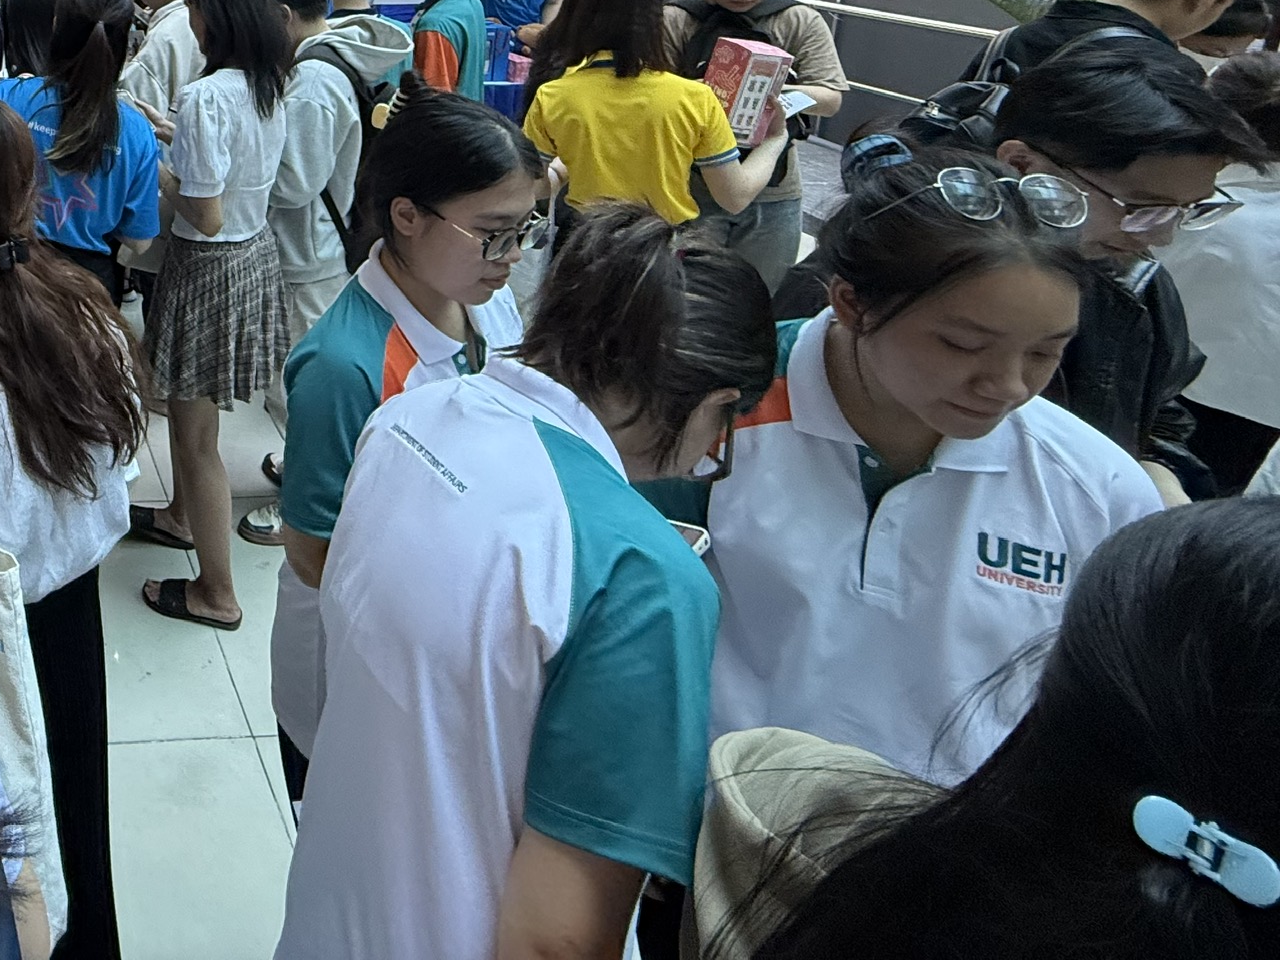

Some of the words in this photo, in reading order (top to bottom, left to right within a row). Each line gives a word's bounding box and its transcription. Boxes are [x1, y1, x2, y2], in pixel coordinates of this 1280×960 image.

[27, 120, 58, 137] #keep
[421, 449, 445, 472] STUDENT
[440, 467, 469, 494] AFFAIRS
[977, 531, 1067, 585] UEH
[976, 564, 1063, 597] UNIVERSITY
